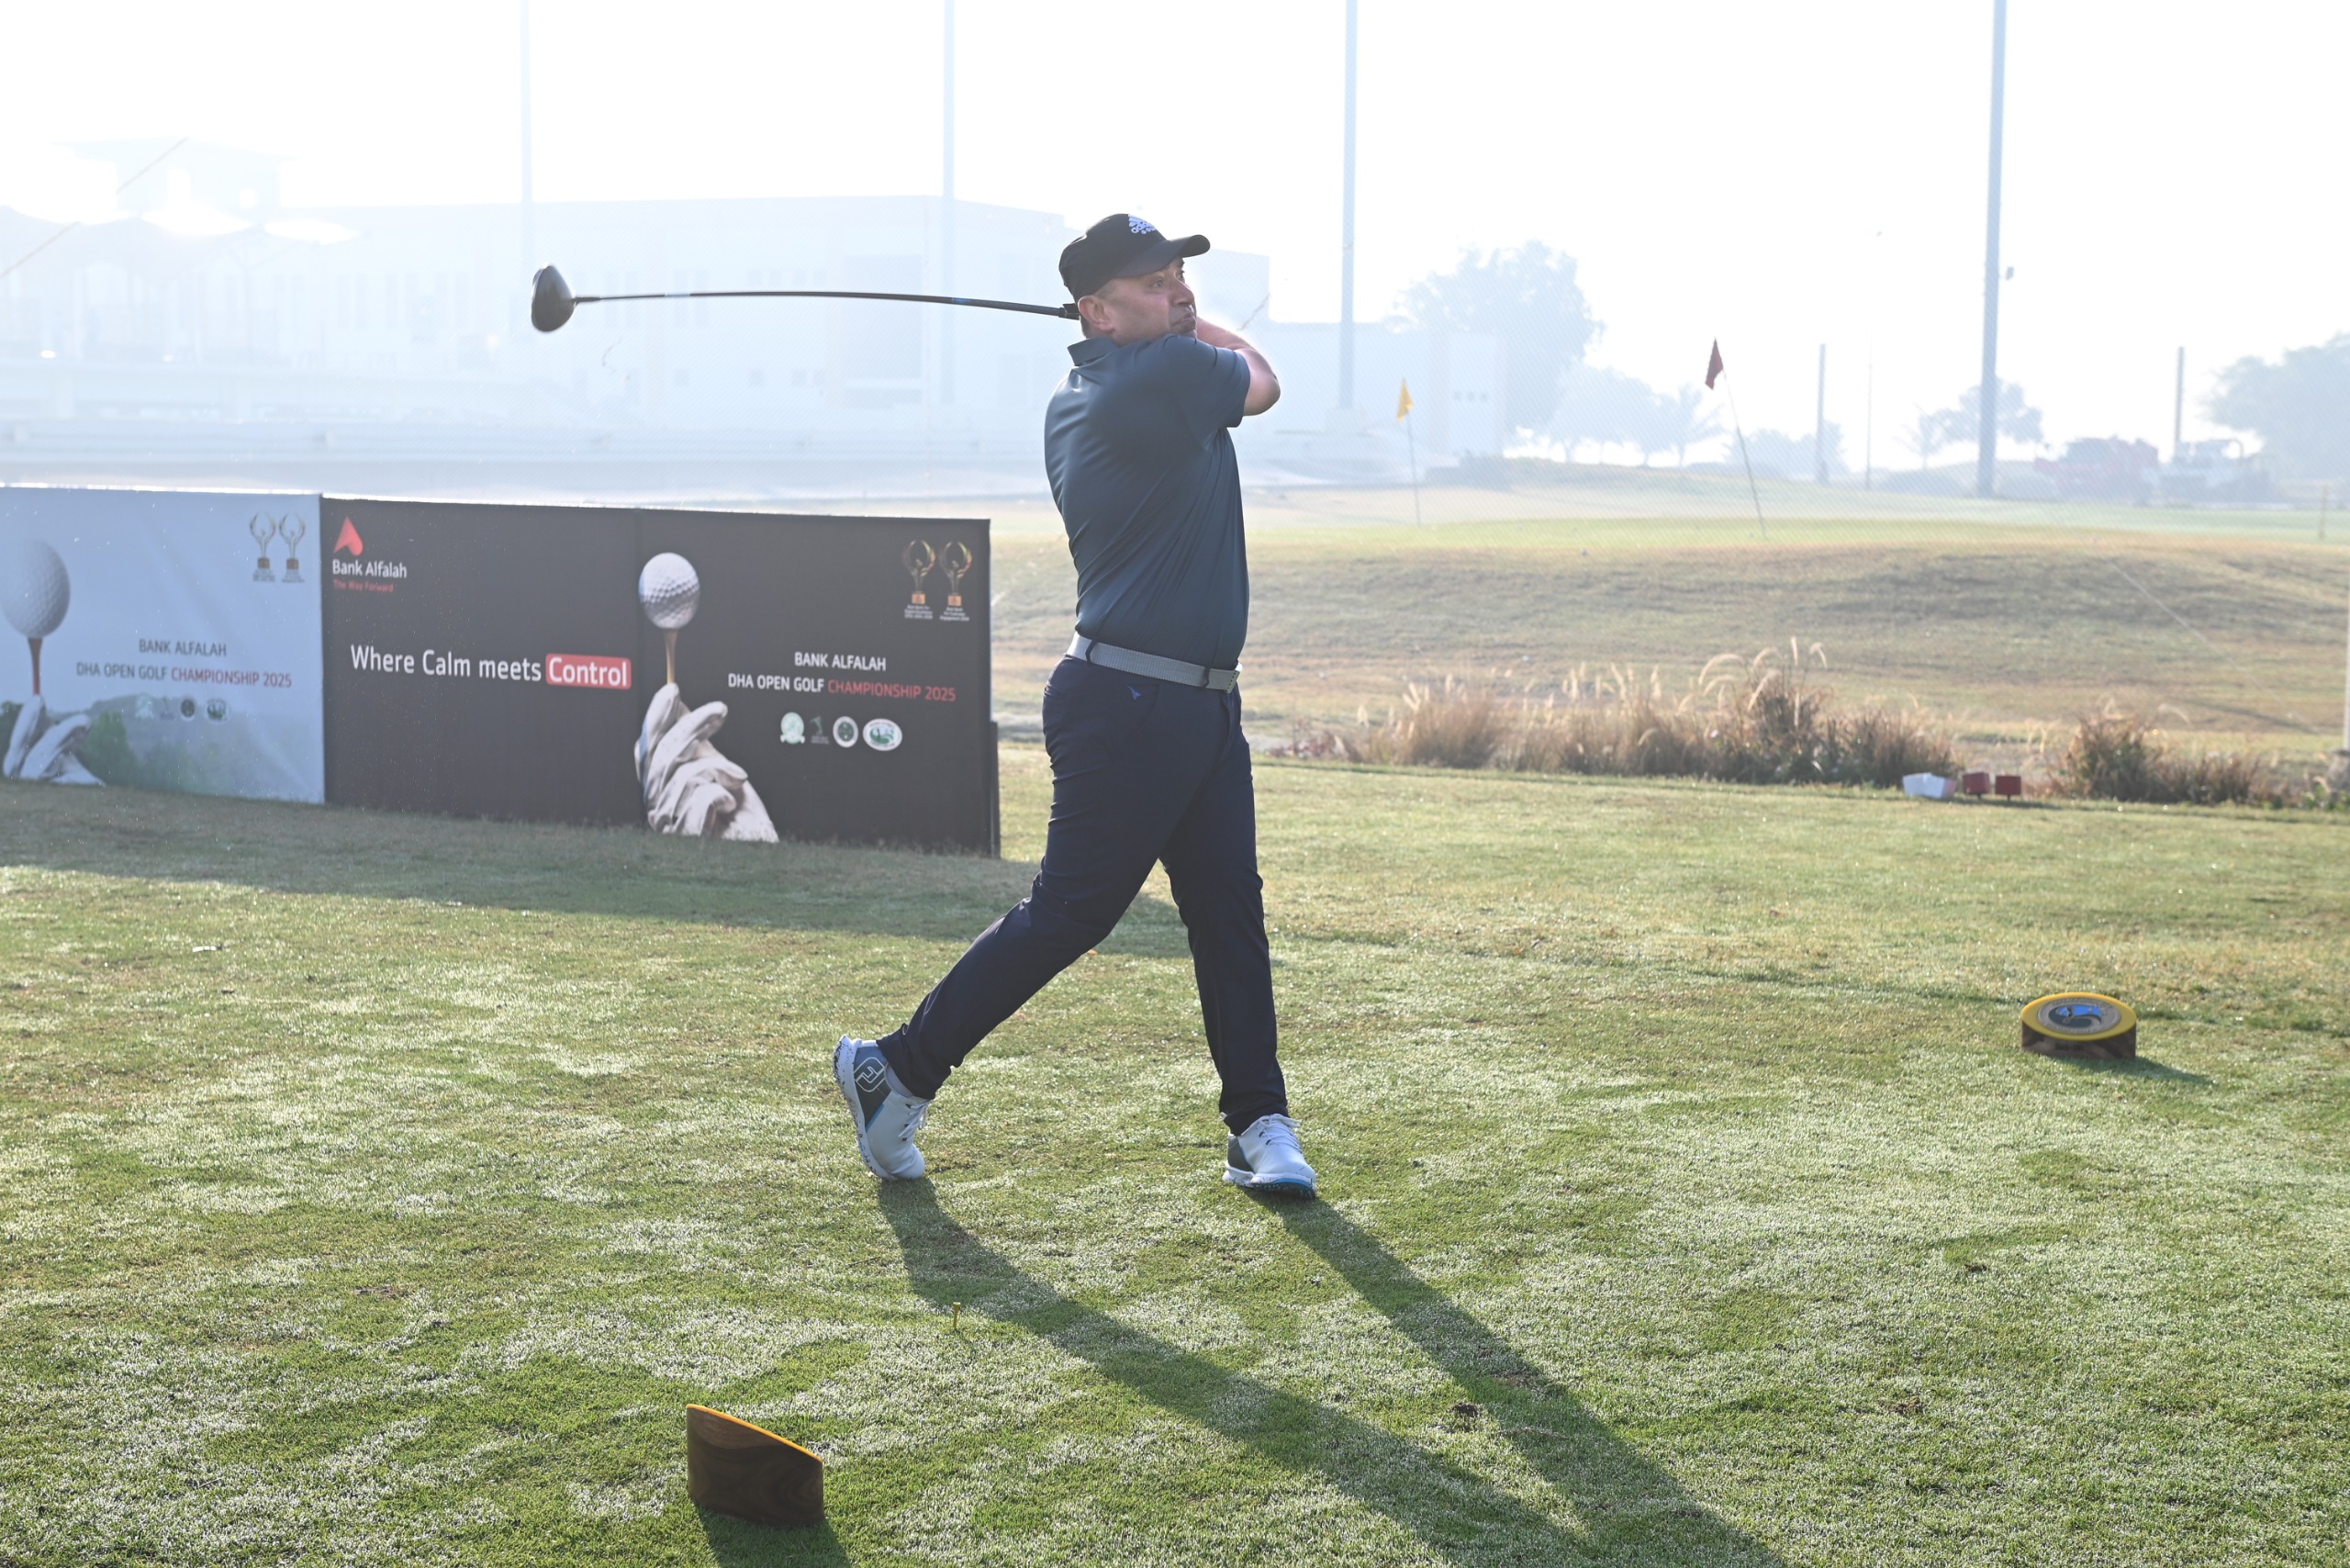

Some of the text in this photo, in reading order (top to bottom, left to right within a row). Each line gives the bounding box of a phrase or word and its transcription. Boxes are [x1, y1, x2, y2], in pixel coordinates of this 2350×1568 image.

[332, 559, 408, 579] Bank Alfalah
[140, 639, 227, 656] BANK ALFALAH
[351, 644, 627, 687] Where Calm meets Control
[794, 651, 887, 671] BANK ALFALAH
[76, 661, 292, 689] DHA OPEN GOLF CHAMPIONSHIP 2025
[728, 673, 957, 701] DHA OPEN GOLF CHAMPIONSHIP 2025
